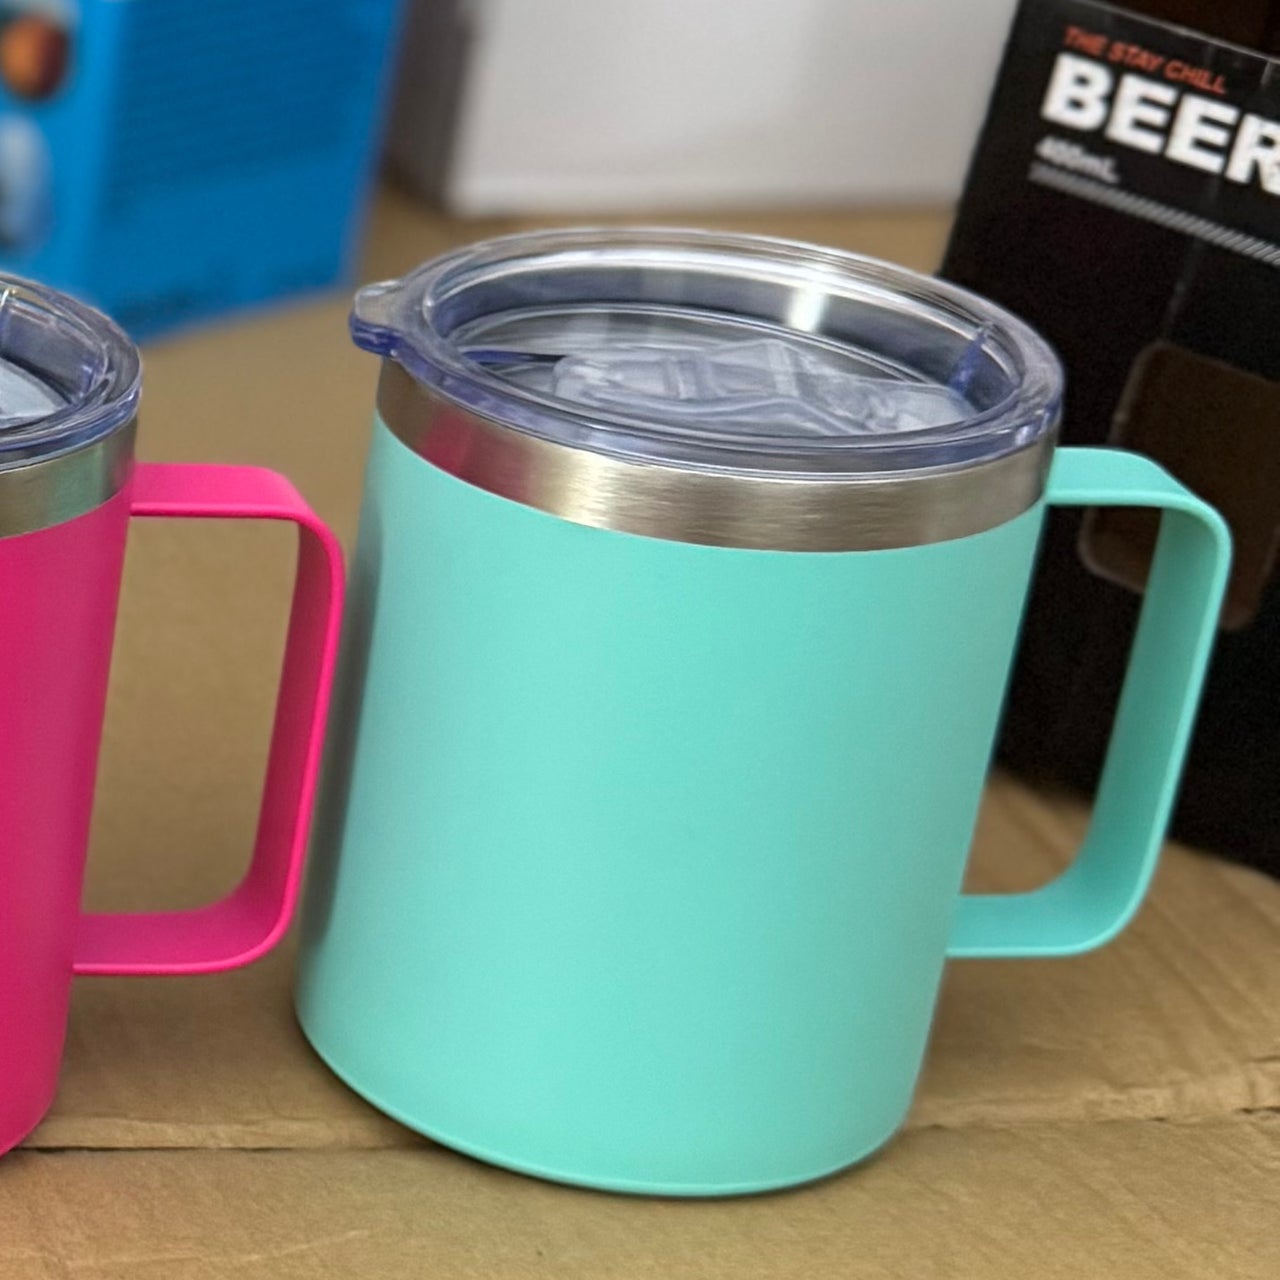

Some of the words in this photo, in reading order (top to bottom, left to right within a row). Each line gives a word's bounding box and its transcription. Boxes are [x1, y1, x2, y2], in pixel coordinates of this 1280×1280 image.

[1064, 25, 1108, 58] THE
[1108, 41, 1165, 73] STAY
[1164, 59, 1227, 95] CHILL
[1041, 51, 1280, 197] BEER
